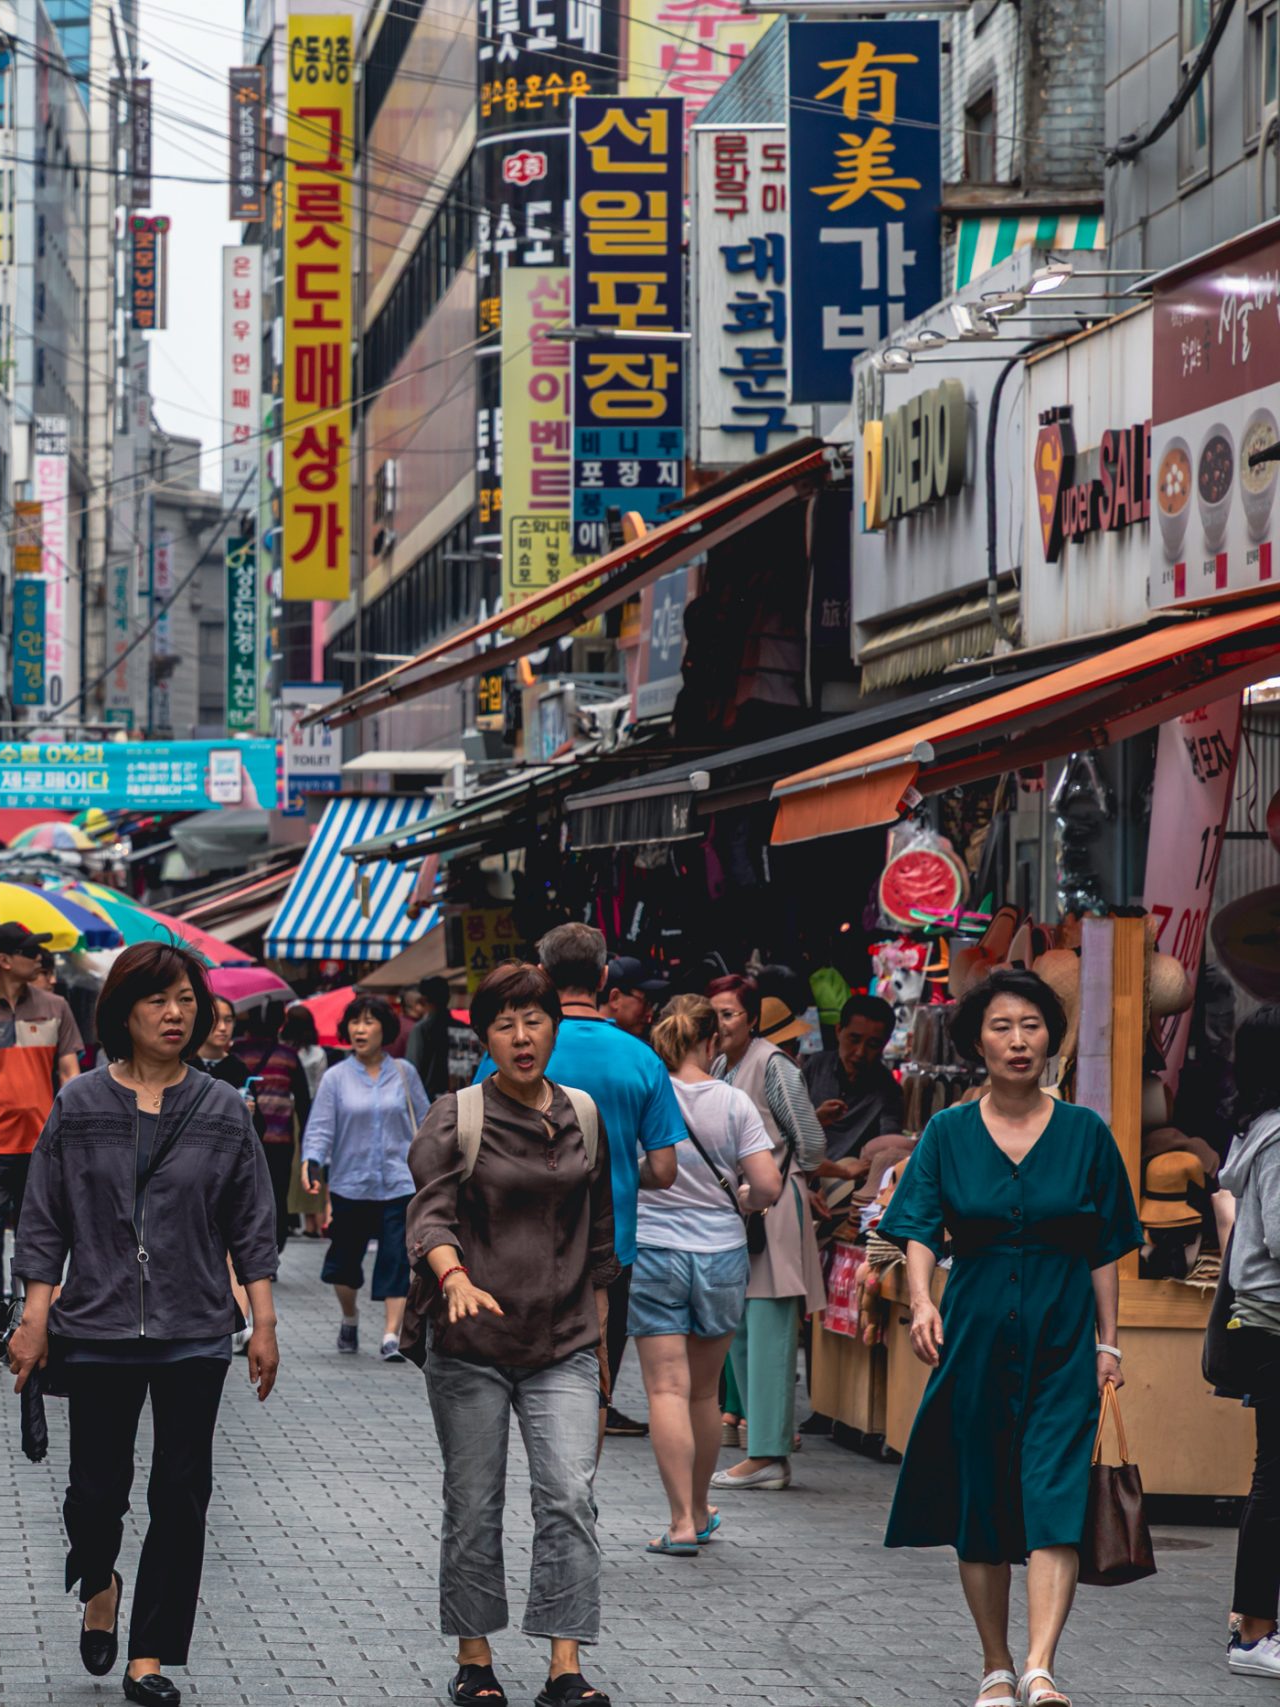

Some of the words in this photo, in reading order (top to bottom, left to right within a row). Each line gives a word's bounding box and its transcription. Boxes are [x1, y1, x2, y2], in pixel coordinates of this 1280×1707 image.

[291, 107, 346, 568] 그릇도매상가
[578, 108, 678, 420] 선일포장
[581, 461, 679, 487] 포장지
